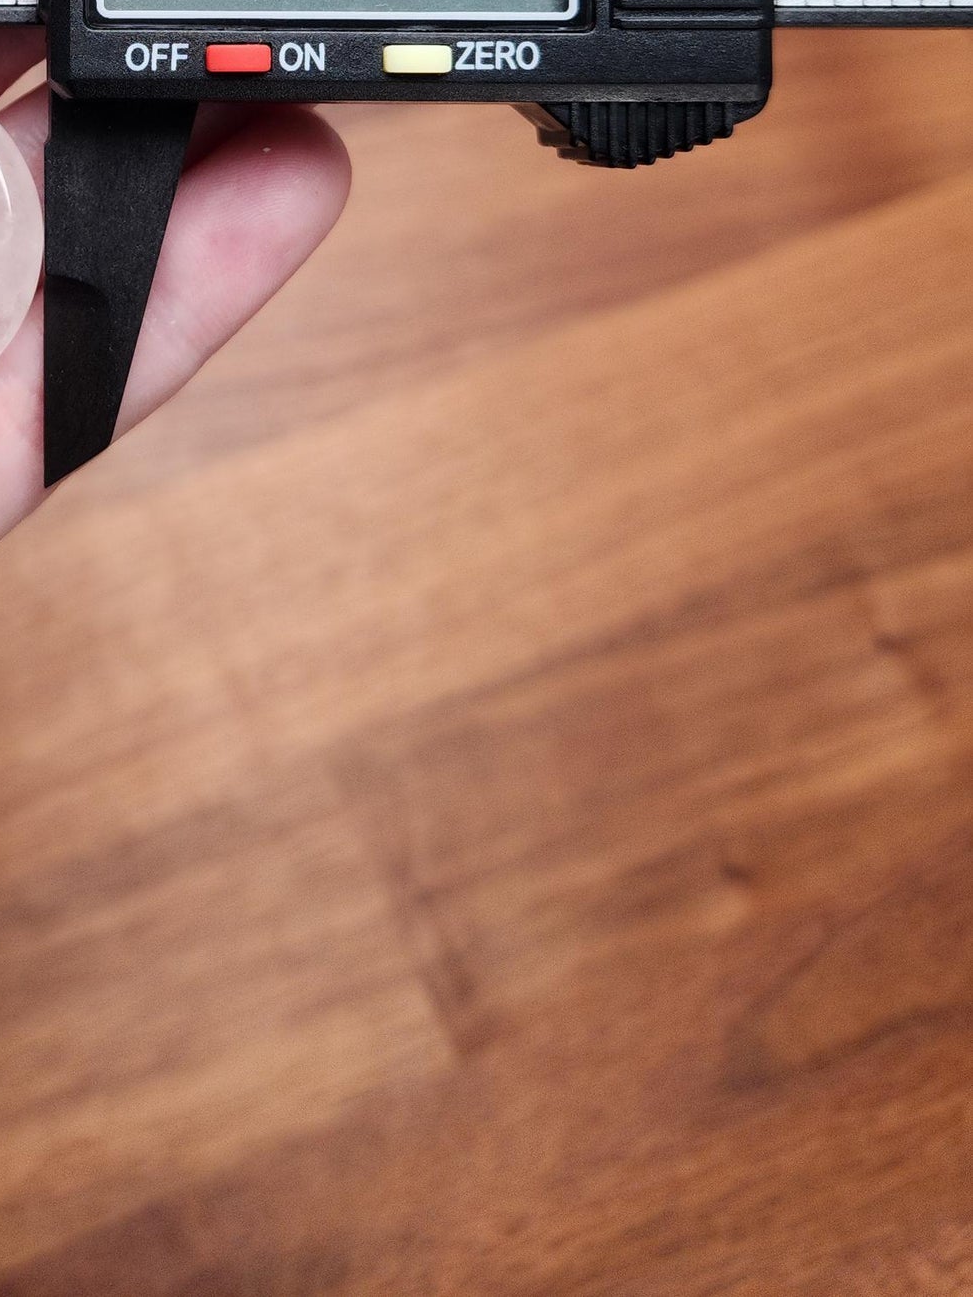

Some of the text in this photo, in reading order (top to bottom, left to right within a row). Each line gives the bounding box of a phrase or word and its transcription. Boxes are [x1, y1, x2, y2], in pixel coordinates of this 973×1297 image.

[124, 41, 541, 72] OFF ON ZERO
